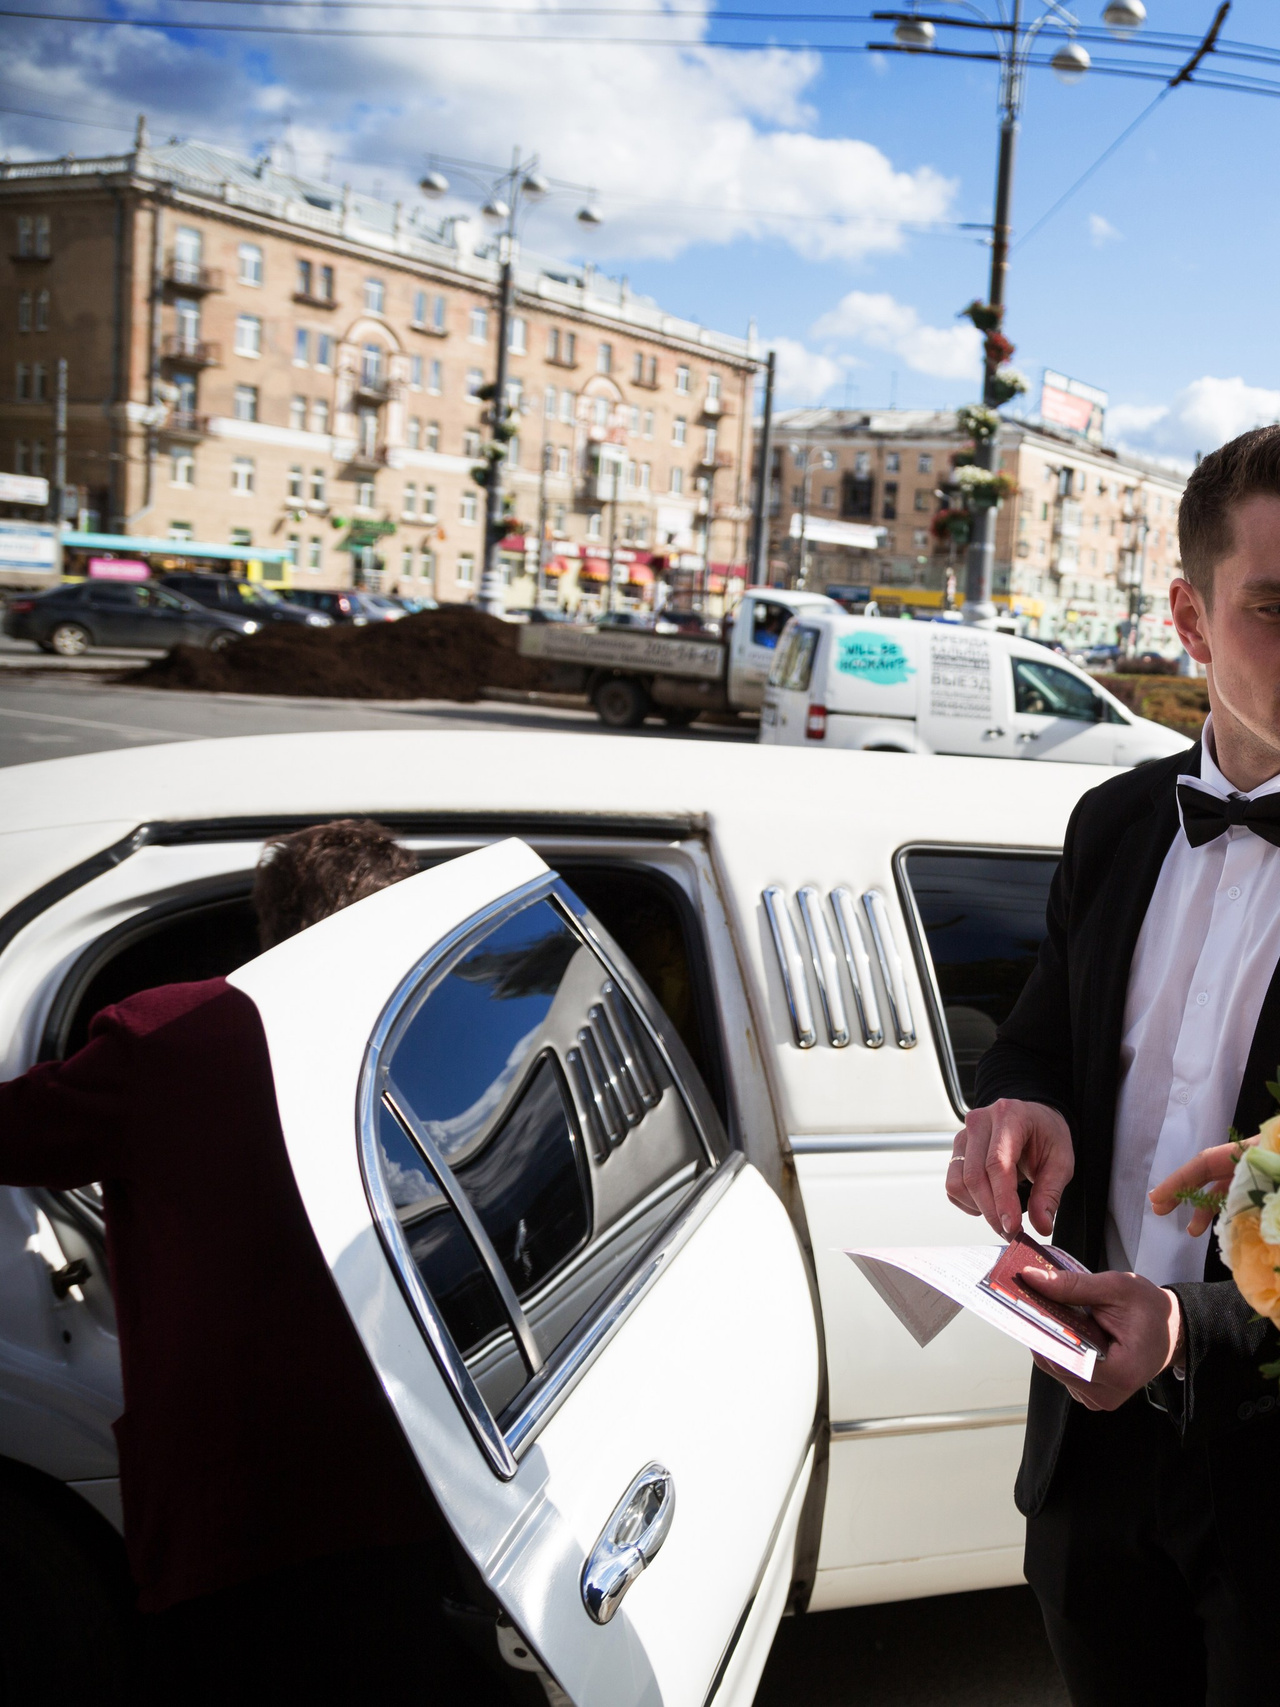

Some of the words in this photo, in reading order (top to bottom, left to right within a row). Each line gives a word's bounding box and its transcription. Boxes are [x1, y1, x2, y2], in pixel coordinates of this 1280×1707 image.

[931, 634, 990, 646] АРЕНДА
[846, 643, 875, 655] WILL
[932, 672, 990, 691] ВЫЕЗД
